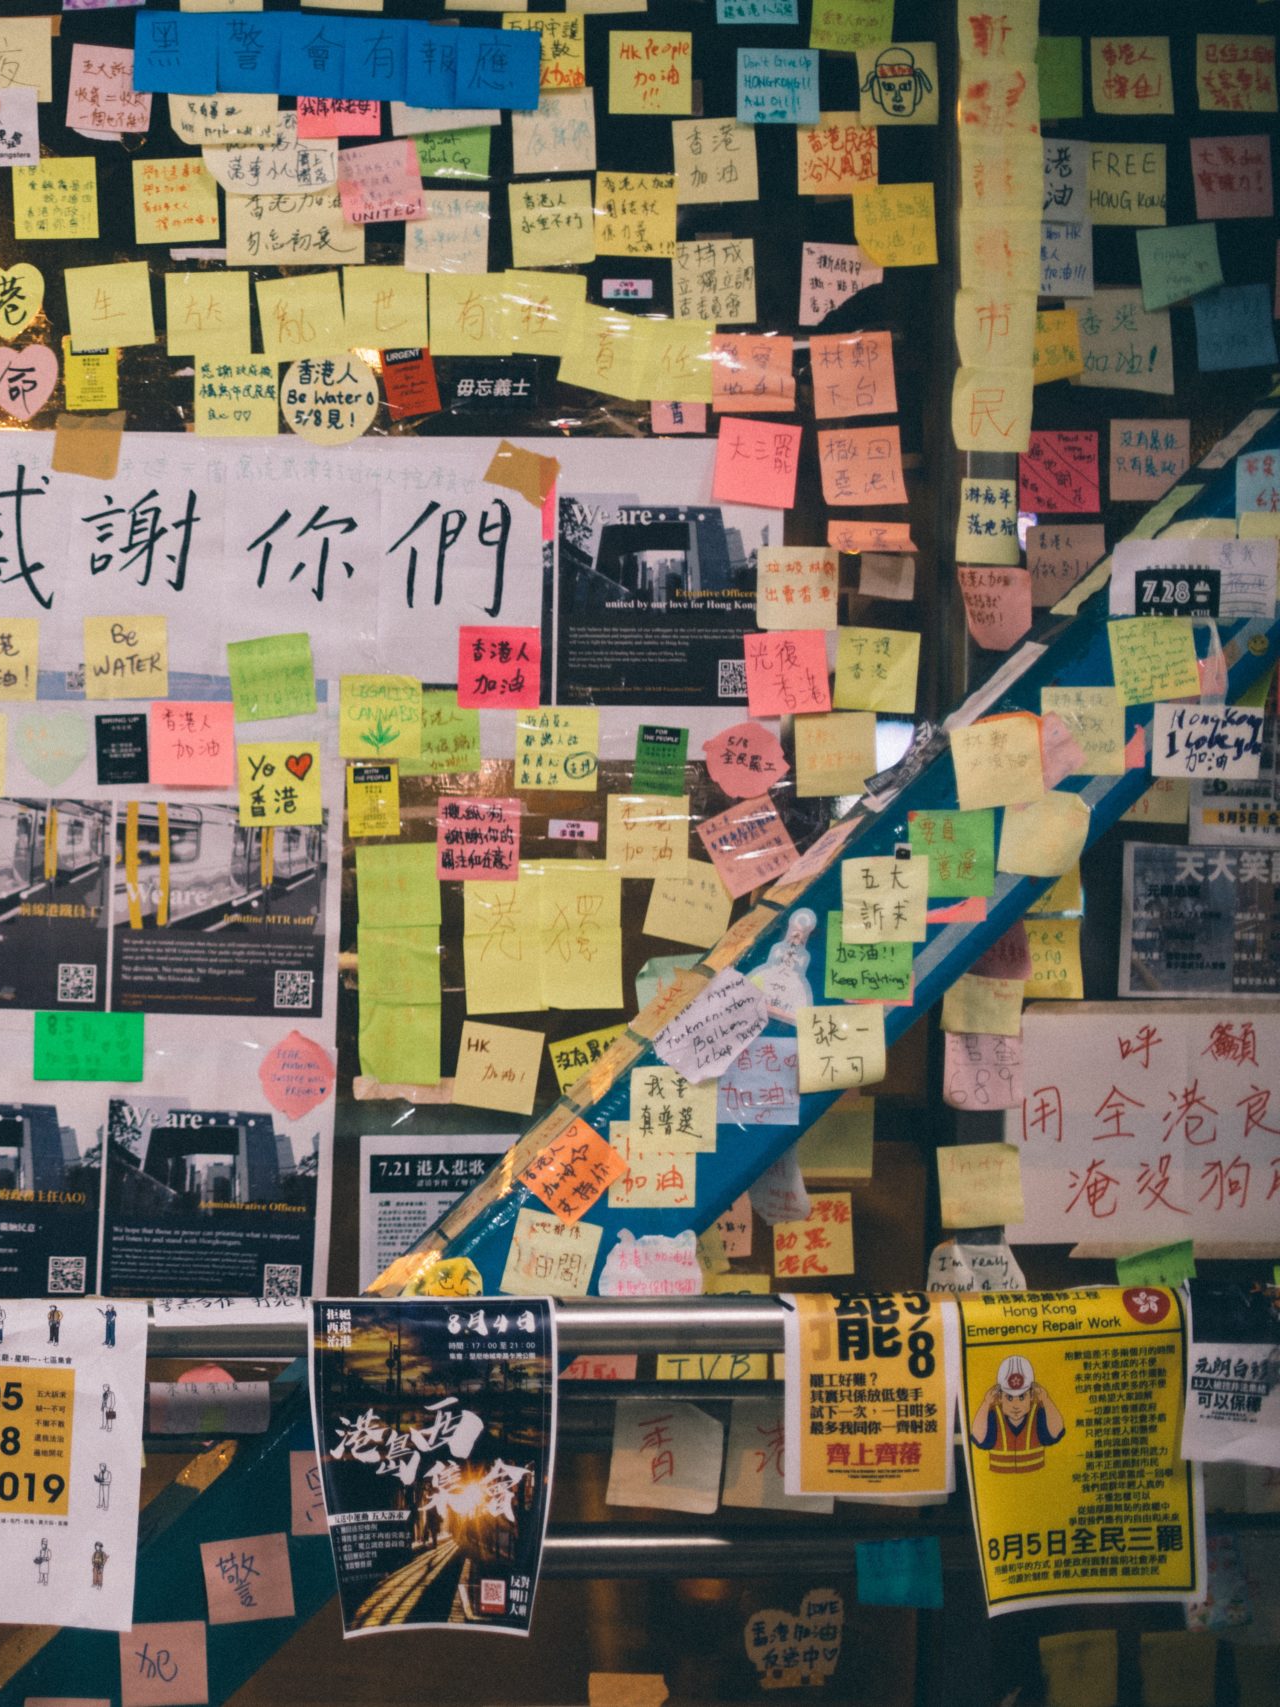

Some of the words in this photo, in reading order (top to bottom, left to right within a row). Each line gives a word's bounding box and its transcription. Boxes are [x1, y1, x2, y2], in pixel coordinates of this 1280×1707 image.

[634, 70, 678, 88] 加油
[687, 125, 739, 154] 香港
[1092, 151, 1157, 174] FREE
[690, 168, 739, 186] 加油
[1088, 189, 1131, 212] HONG
[297, 360, 359, 386] 香港人
[286, 390, 308, 406] Be
[314, 389, 363, 406] Water
[456, 378, 531, 398] 毋忘義士
[729, 433, 794, 474] 大三罷
[616, 505, 655, 526] are
[1141, 580, 1190, 602] 7.28
[604, 600, 634, 610] united
[636, 600, 648, 612] by
[669, 600, 689, 610] love
[706, 600, 732, 613] Hong
[110, 624, 139, 648] Be
[471, 638, 531, 663] 香港人
[93, 652, 162, 678] WATER
[474, 672, 527, 697] 加油
[162, 709, 212, 734] 香港人
[176, 739, 221, 759] 加油
[657, 735, 680, 743] PEOPLE
[251, 788, 299, 817] 香港
[860, 866, 911, 891] 五大
[265, 914, 290, 924] MTR
[293, 914, 316, 926] staff
[467, 1038, 491, 1054] HK
[121, 1105, 160, 1130] We
[165, 1107, 203, 1130] are
[640, 1104, 704, 1139] 真普選
[380, 1161, 411, 1178] 7.21
[624, 1163, 686, 1191] 加油
[268, 1202, 307, 1213] Officers
[327, 1308, 352, 1322] 拒絕
[447, 1309, 536, 1337] 8月4日
[1003, 1305, 1038, 1321] Hong
[1041, 1303, 1077, 1319] Kong
[327, 1322, 352, 1336] 西環
[967, 1321, 1038, 1338] Emergency
[1042, 1318, 1084, 1333] Repair
[1087, 1316, 1122, 1330] Work
[327, 1336, 352, 1349] 治港
[668, 1355, 753, 1381] TVB
[36, 1389, 67, 1399] 五大訴求
[825, 1440, 922, 1466] 齊上齊落
[987, 1524, 1184, 1562] 8月5日全民三罷
